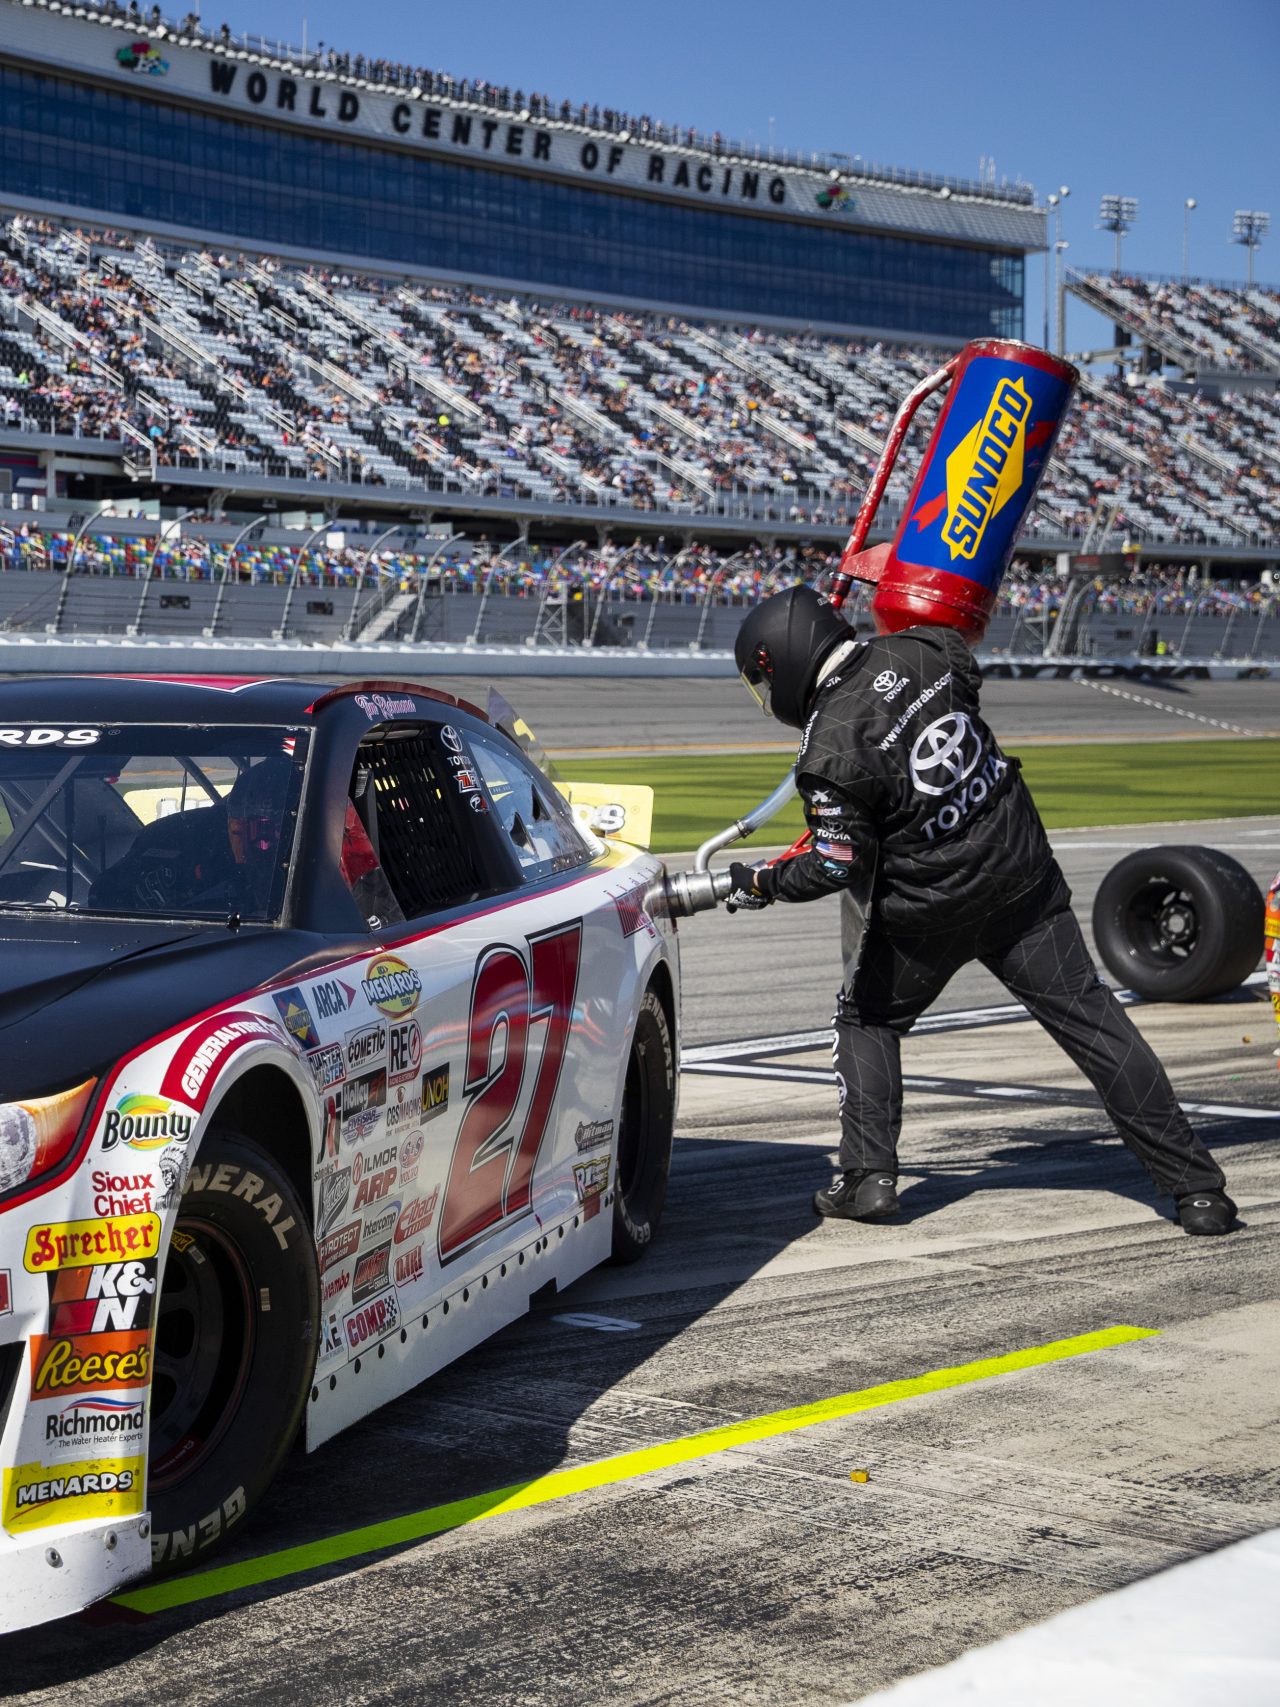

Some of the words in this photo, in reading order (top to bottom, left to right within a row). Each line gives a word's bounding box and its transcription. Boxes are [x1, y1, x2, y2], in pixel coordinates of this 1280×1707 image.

[209, 58, 360, 122] WORLD
[391, 103, 552, 161] CENTER
[579, 141, 623, 174] OF
[646, 154, 786, 204] RACING
[947, 383, 1028, 554] SUNOCO
[825, 675, 842, 688] OTA
[883, 676, 910, 703] TOYOTA
[978, 663, 1211, 681] AYTONA
[878, 671, 954, 752] www.teamrab.com
[920, 754, 1009, 841] TOYOTA
[816, 828, 852, 842] TOYOTA
[311, 980, 347, 1020] ARCA
[361, 968, 422, 1005] MENARDS
[180, 1022, 242, 1100] GENERAL
[348, 1023, 386, 1064] COMETIC
[343, 1080, 369, 1112] Holley
[422, 1077, 449, 1111] UNOH
[439, 916, 583, 1268] 27
[100, 1109, 193, 1152] Bounty
[91, 1171, 156, 1193] Sioux
[352, 1166, 398, 1211] ARP
[94, 1192, 151, 1217] Chief
[177, 1162, 299, 1251] NERAL
[31, 1220, 154, 1267] Sprecher
[320, 1226, 359, 1257] PYROTECT
[362, 1211, 397, 1239] Intercomp
[85, 1261, 157, 1300] K&
[346, 1299, 387, 1348] COMP
[34, 1340, 150, 1395] Reese's
[45, 1401, 145, 1440] Richmond
[58, 1439, 70, 1448] The
[72, 1436, 92, 1446] Water
[93, 1435, 117, 1445] Heater
[119, 1432, 143, 1443] Experts
[16, 1470, 134, 1508] MENARDS
[151, 1485, 246, 1563] GENE
